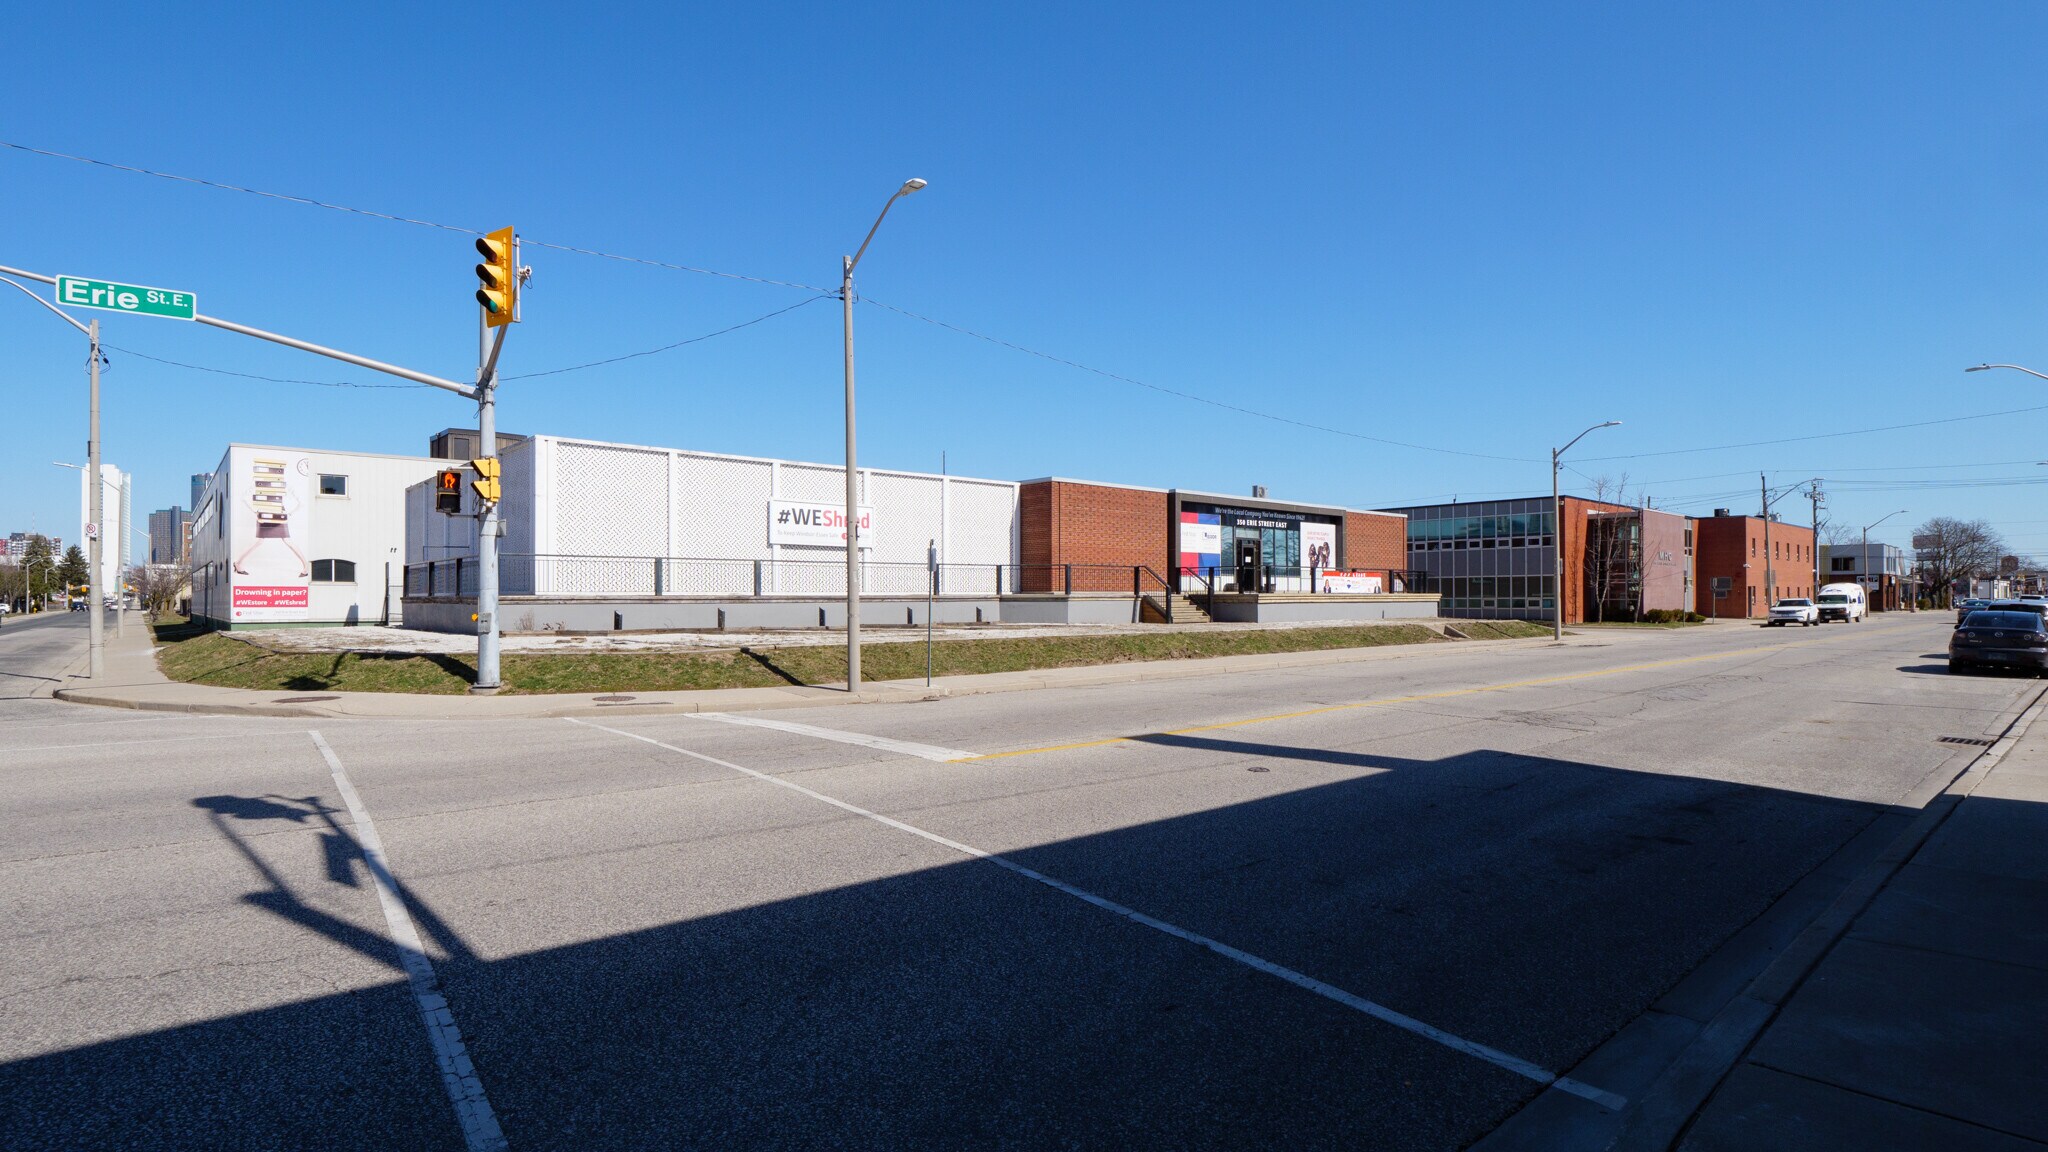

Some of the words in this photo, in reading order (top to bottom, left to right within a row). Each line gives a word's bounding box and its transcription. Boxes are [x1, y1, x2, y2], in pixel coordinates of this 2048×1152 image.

[65, 279, 139, 309] Erie
[147, 290, 170, 305] St.
[173, 294, 188, 307] E.
[235, 588, 272, 597] Drowning
[273, 588, 280, 596] in
[281, 589, 307, 597] paper?
